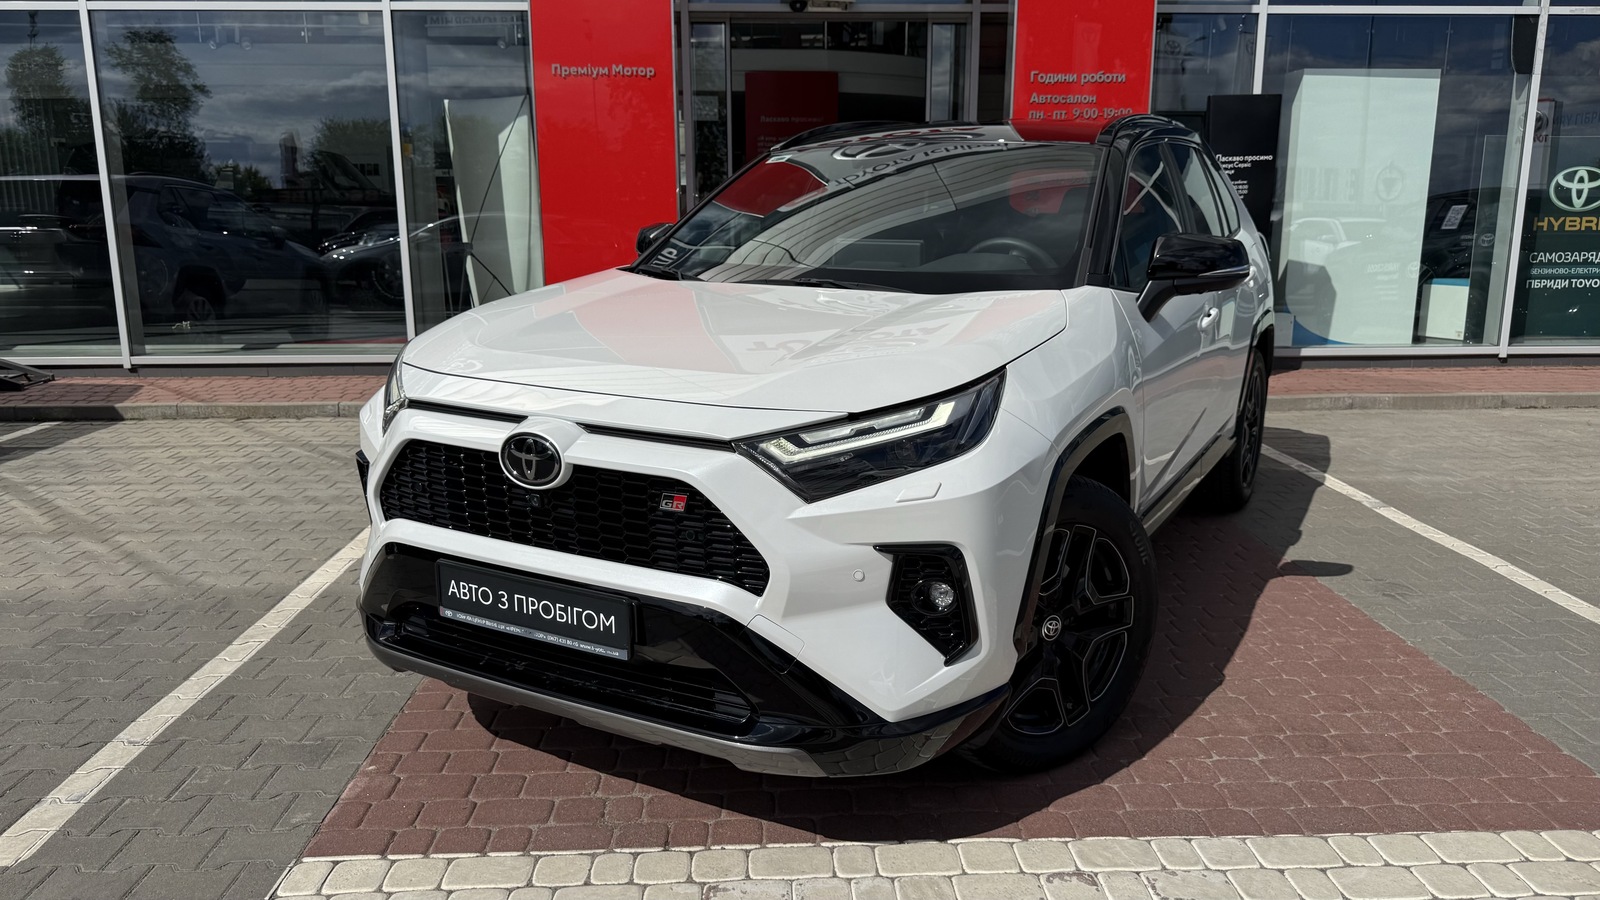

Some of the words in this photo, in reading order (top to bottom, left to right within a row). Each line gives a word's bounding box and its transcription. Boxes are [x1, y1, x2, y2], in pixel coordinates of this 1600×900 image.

[551, 63, 609, 79] Преміум
[612, 64, 655, 79] Мотор
[1030, 71, 1077, 84] Години
[1081, 71, 1126, 86] роботи
[1029, 92, 1097, 104] Автосалон
[448, 579, 493, 606] АВТО
[498, 590, 509, 610] З
[514, 594, 616, 635] ПРОБІГОМ
